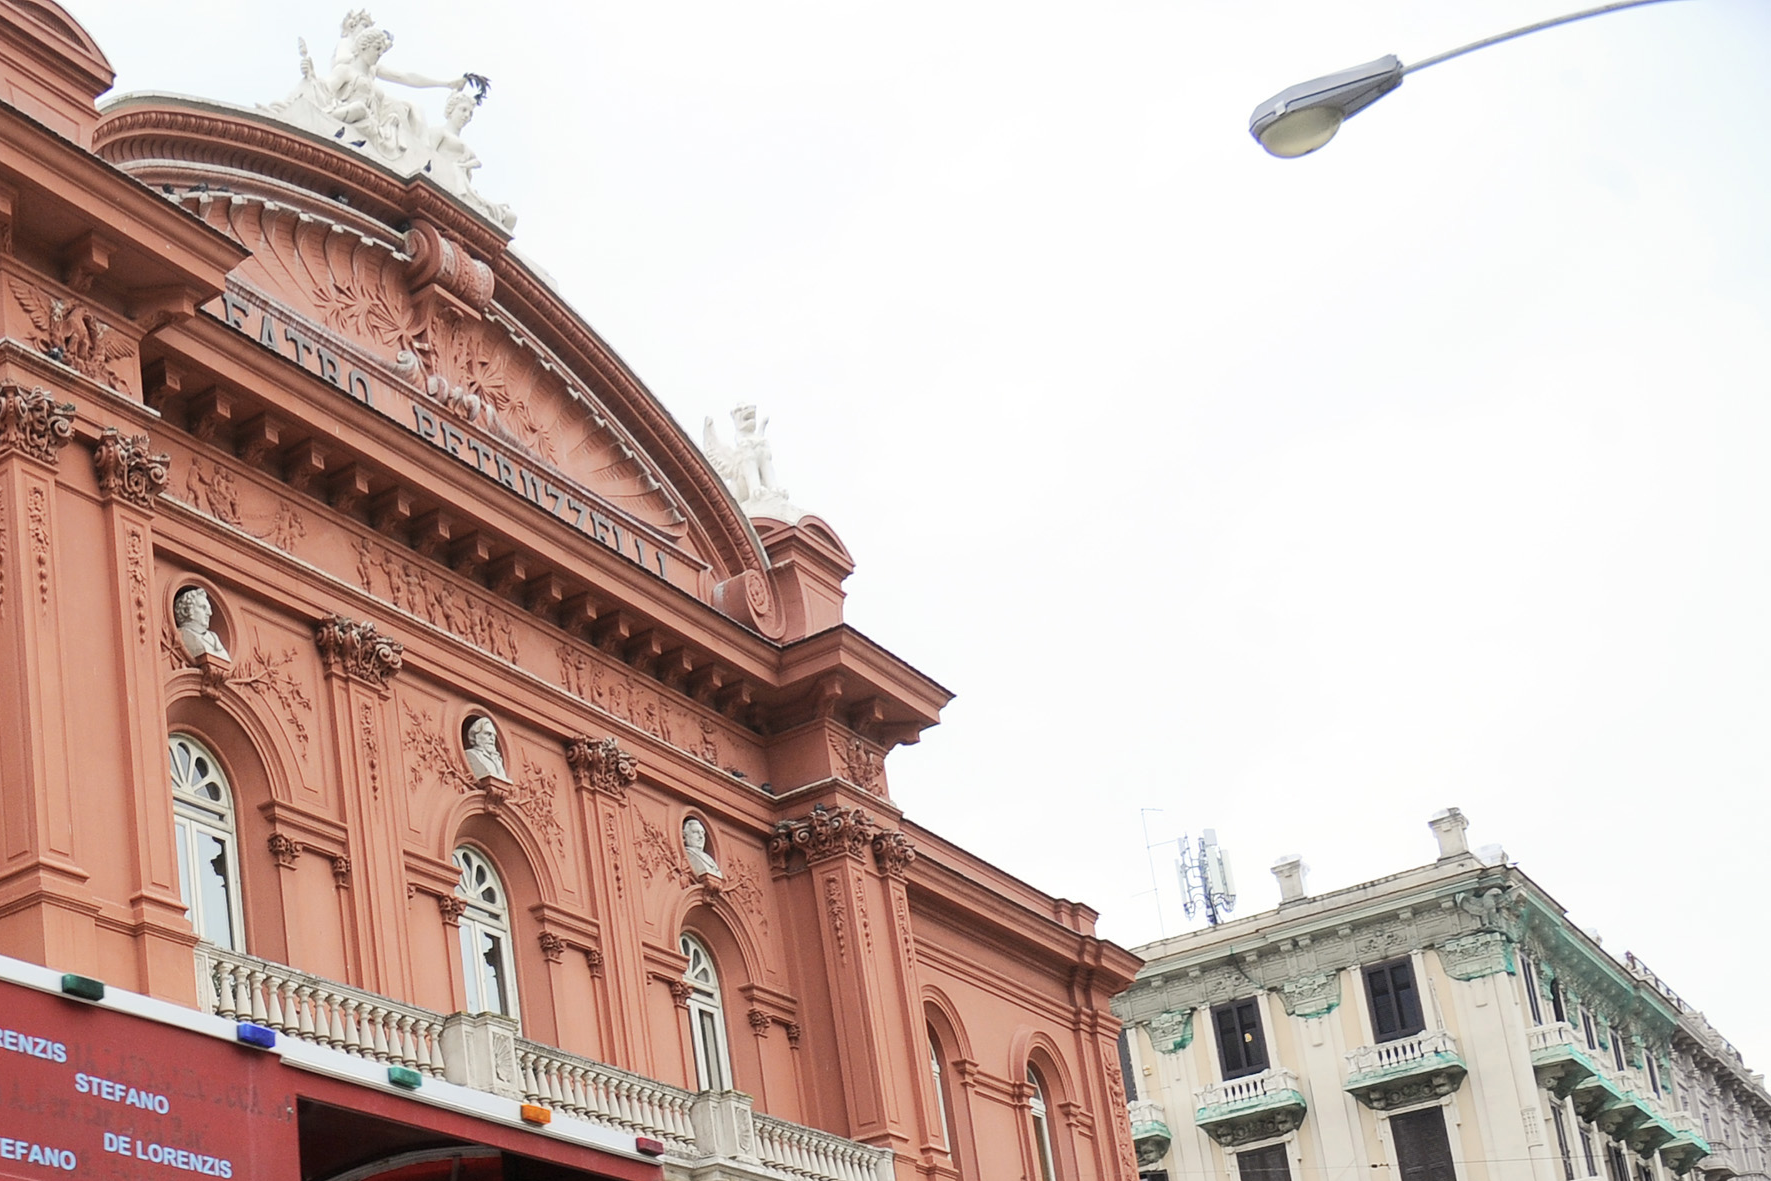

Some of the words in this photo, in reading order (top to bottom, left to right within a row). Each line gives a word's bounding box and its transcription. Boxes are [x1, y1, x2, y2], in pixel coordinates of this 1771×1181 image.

[221, 293, 372, 404] EATRO
[75, 1073, 169, 1114] STEFANO
[104, 1132, 131, 1156] DE
[136, 1140, 232, 1179] LORENZIS
